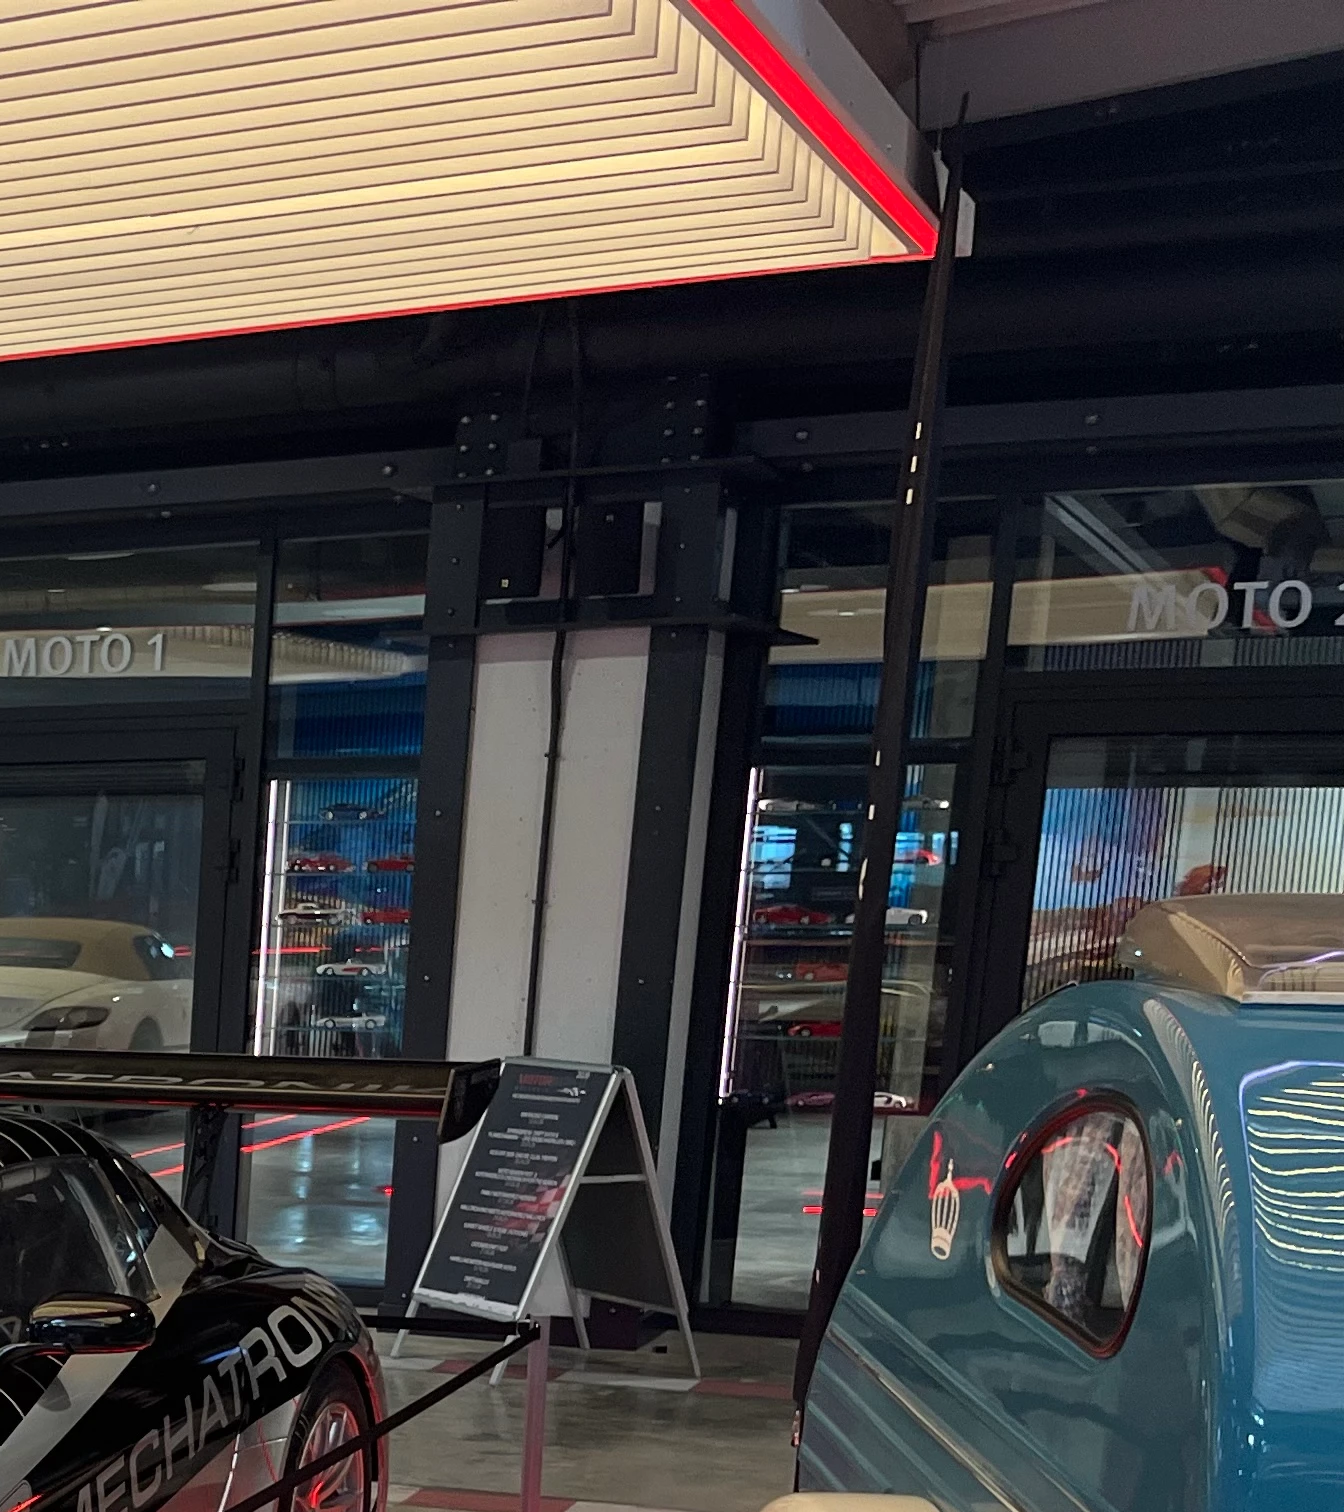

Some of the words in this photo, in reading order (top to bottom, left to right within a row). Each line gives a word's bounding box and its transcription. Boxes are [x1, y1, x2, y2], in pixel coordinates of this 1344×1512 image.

[1127, 579, 1312, 631] MOTO
[4, 633, 131, 678] MOTO
[147, 632, 165, 671] 1
